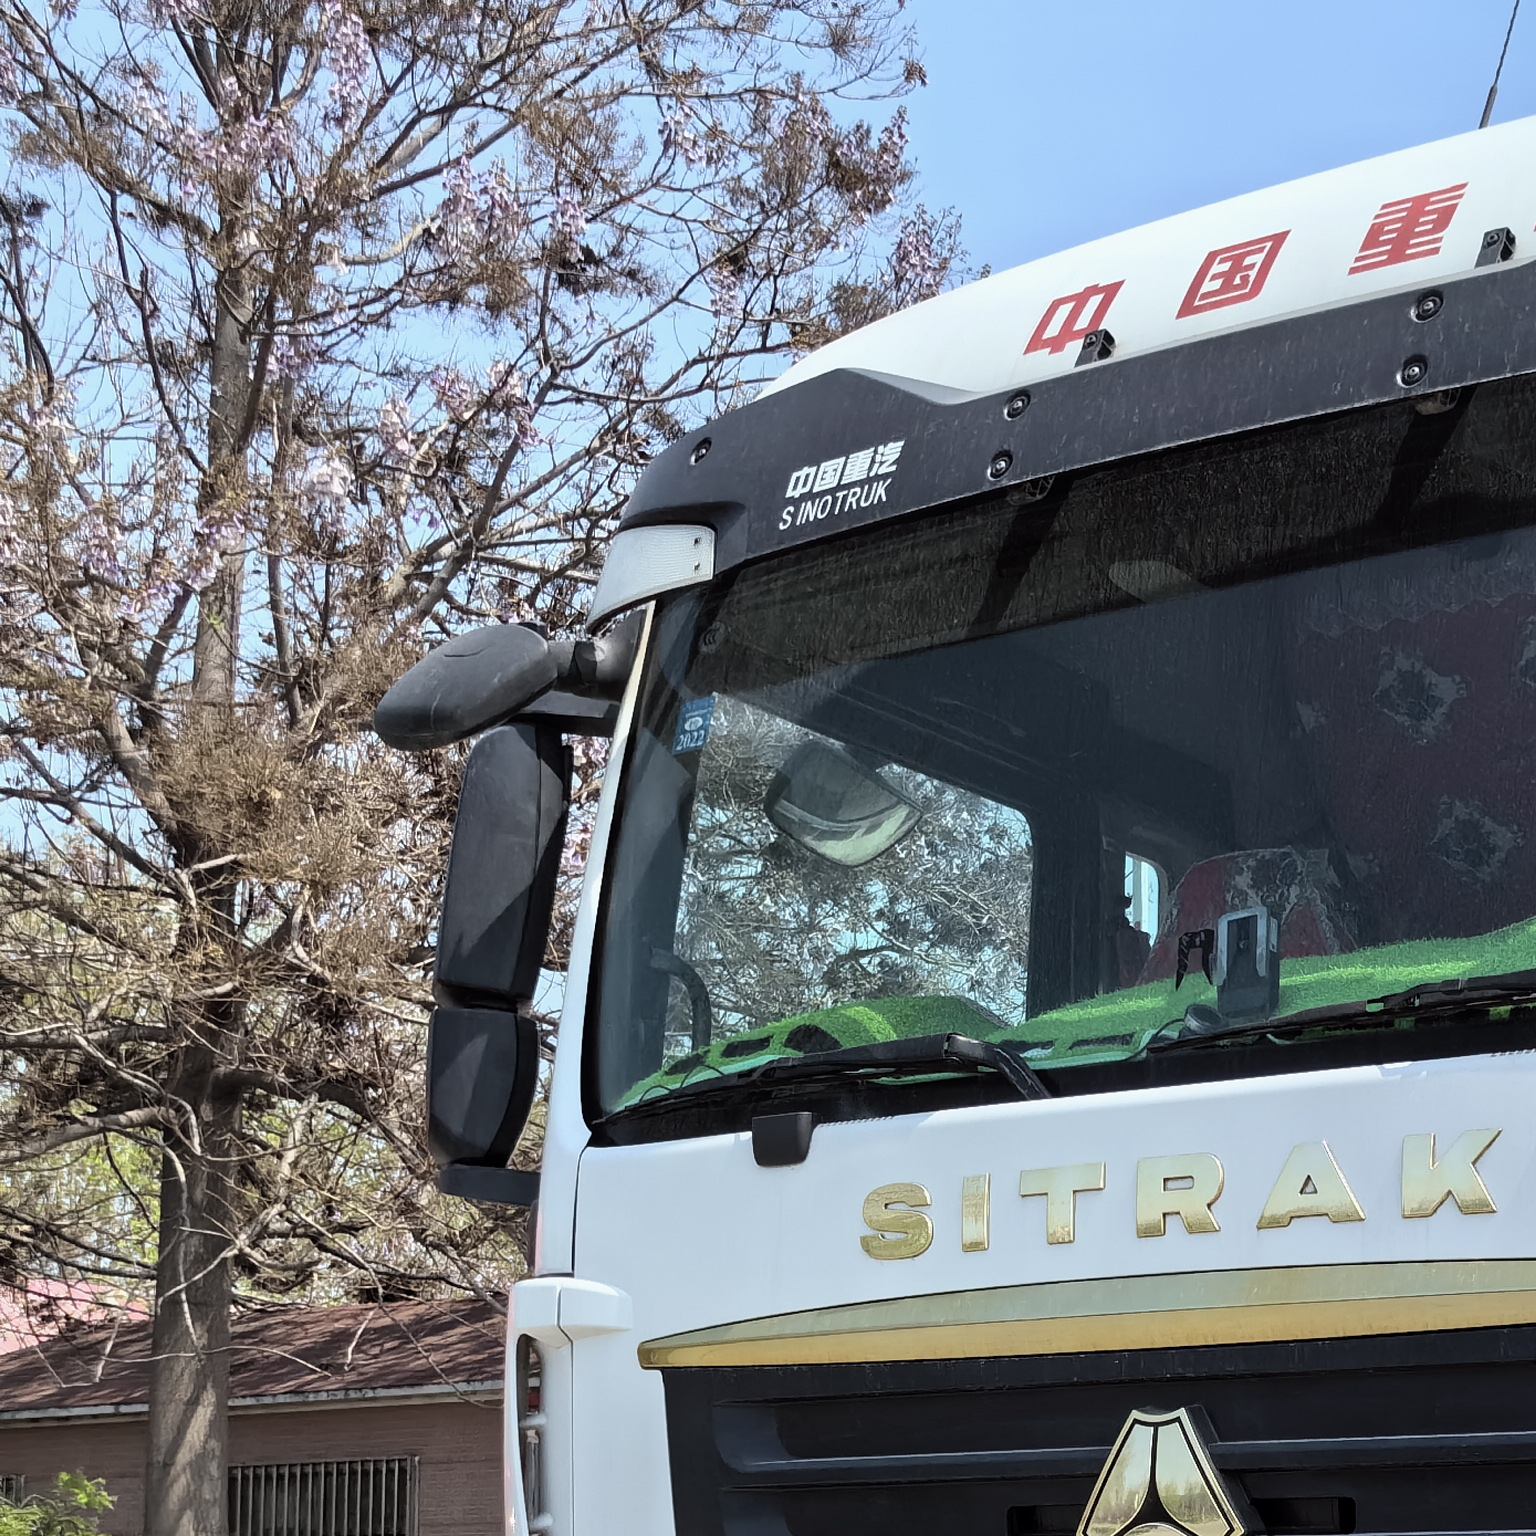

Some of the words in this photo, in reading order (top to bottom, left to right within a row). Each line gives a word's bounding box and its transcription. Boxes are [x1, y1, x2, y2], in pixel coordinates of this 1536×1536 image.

[785, 440, 906, 499] 中国重汽
[778, 478, 893, 531] SINOTRUK
[859, 1127, 1503, 1262] SITRAK
